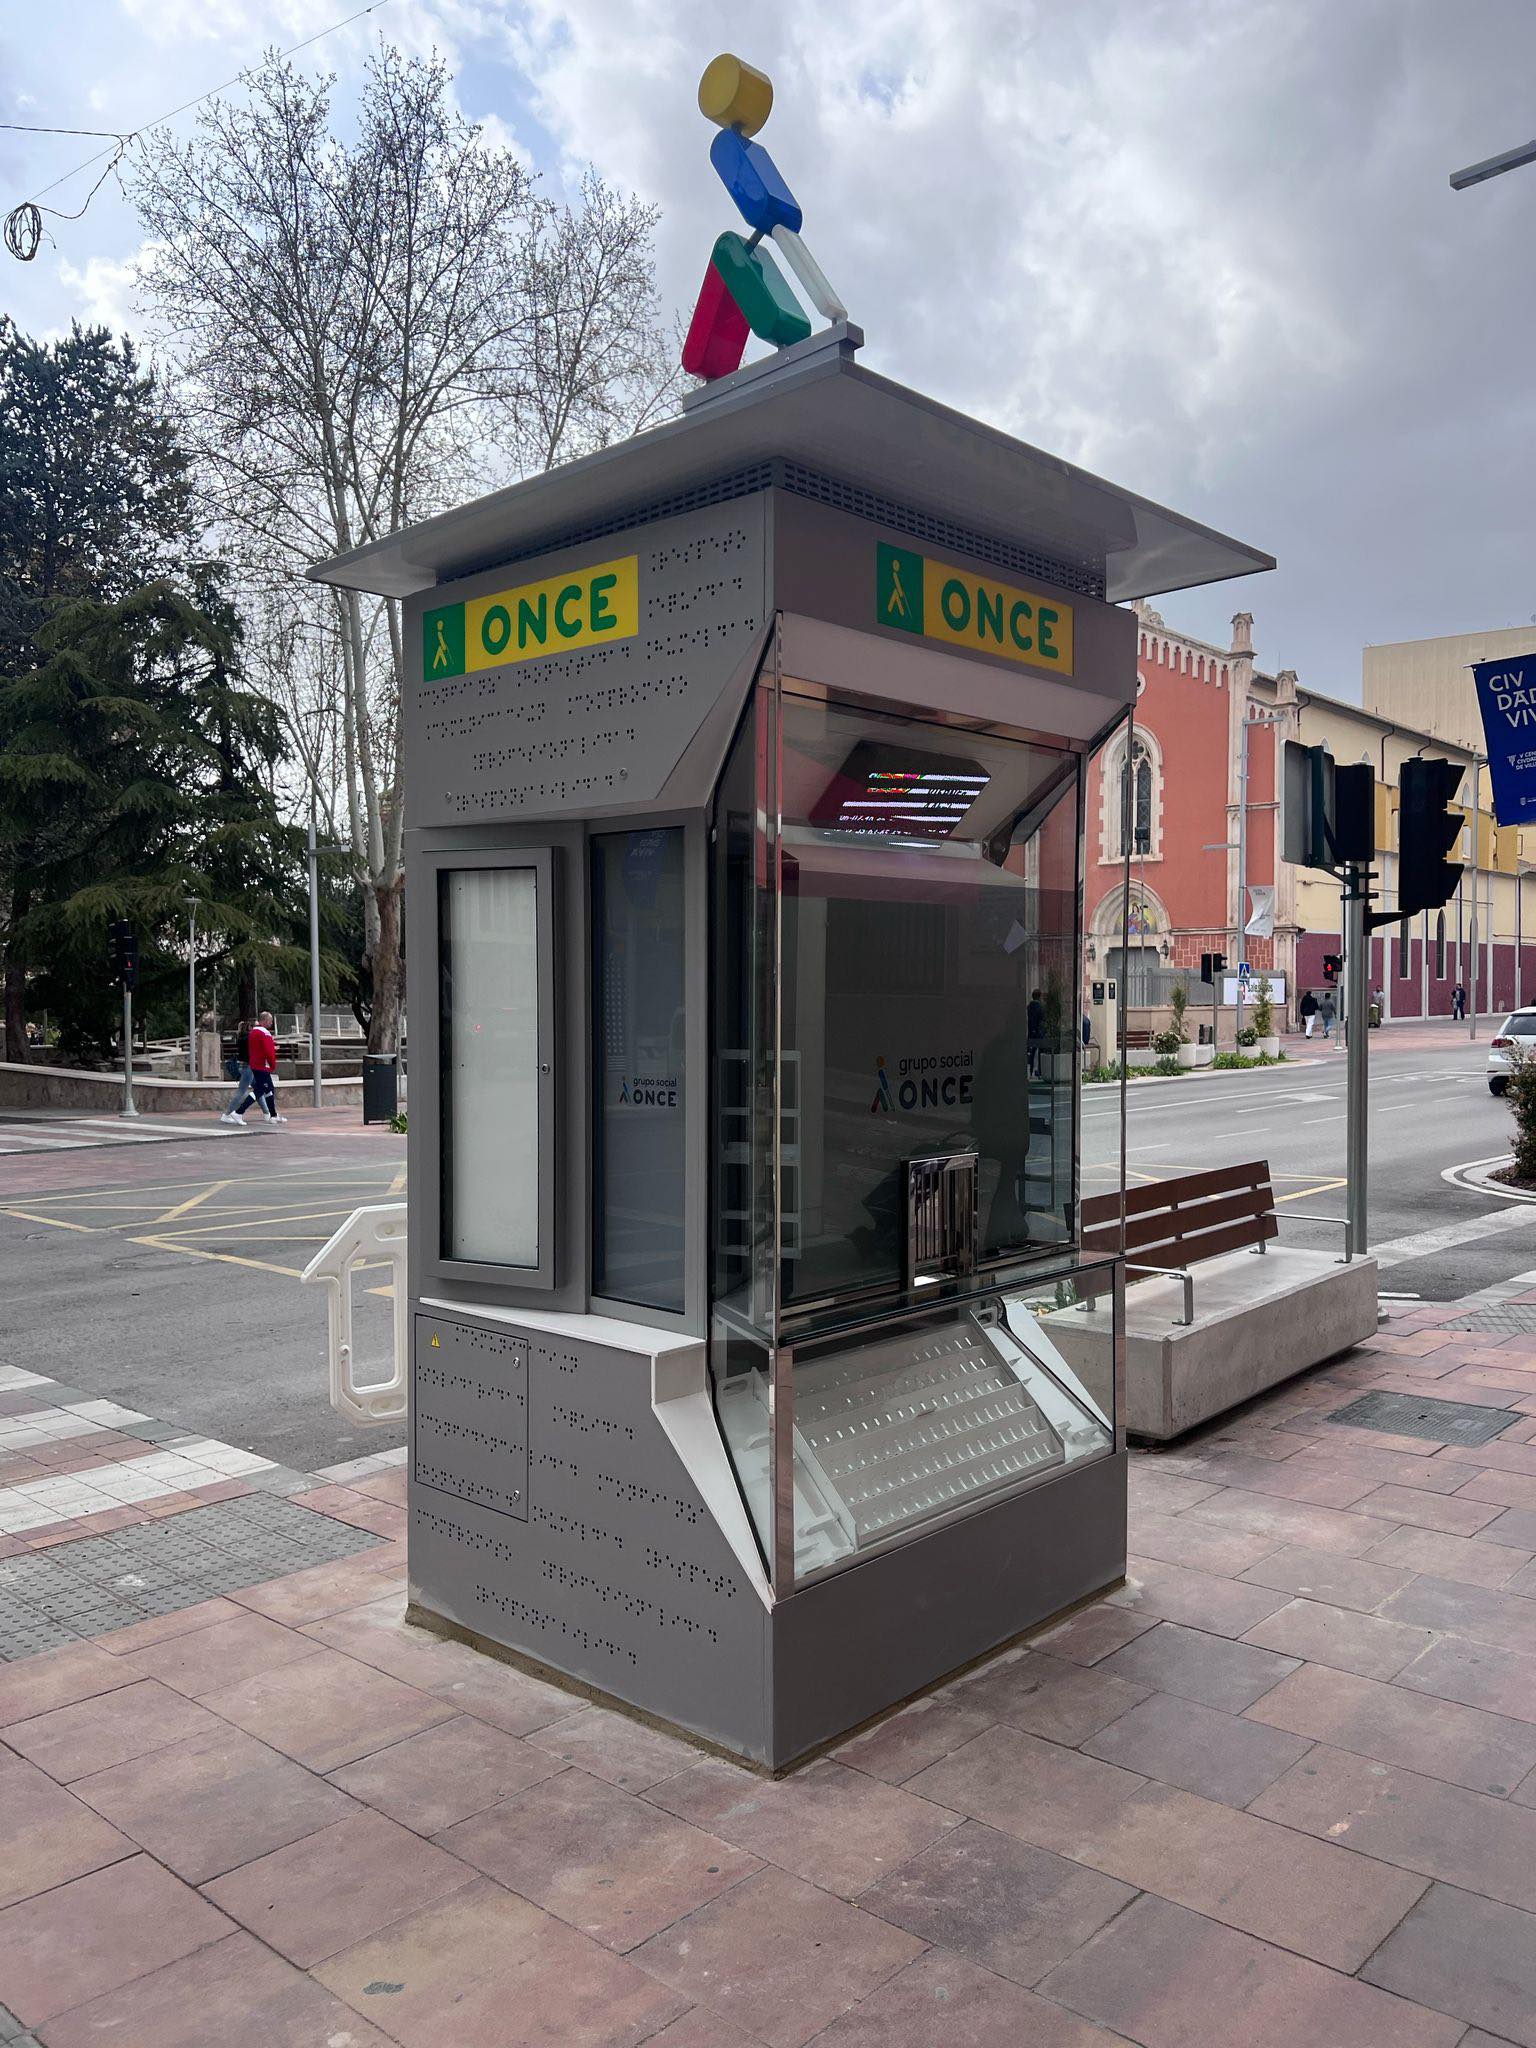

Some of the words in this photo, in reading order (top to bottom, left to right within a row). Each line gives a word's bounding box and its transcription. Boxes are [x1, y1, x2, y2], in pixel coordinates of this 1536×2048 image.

[482, 574, 617, 655] ONCE
[941, 579, 1058, 659] ONCE
[1489, 671, 1523, 691] CIV
[899, 1056, 937, 1075] grupo
[940, 1050, 973, 1068] social
[633, 1078, 655, 1087] grupo
[656, 1077, 677, 1087] social
[899, 1075, 973, 1110] ONCE
[633, 1089, 677, 1107] ONCE
